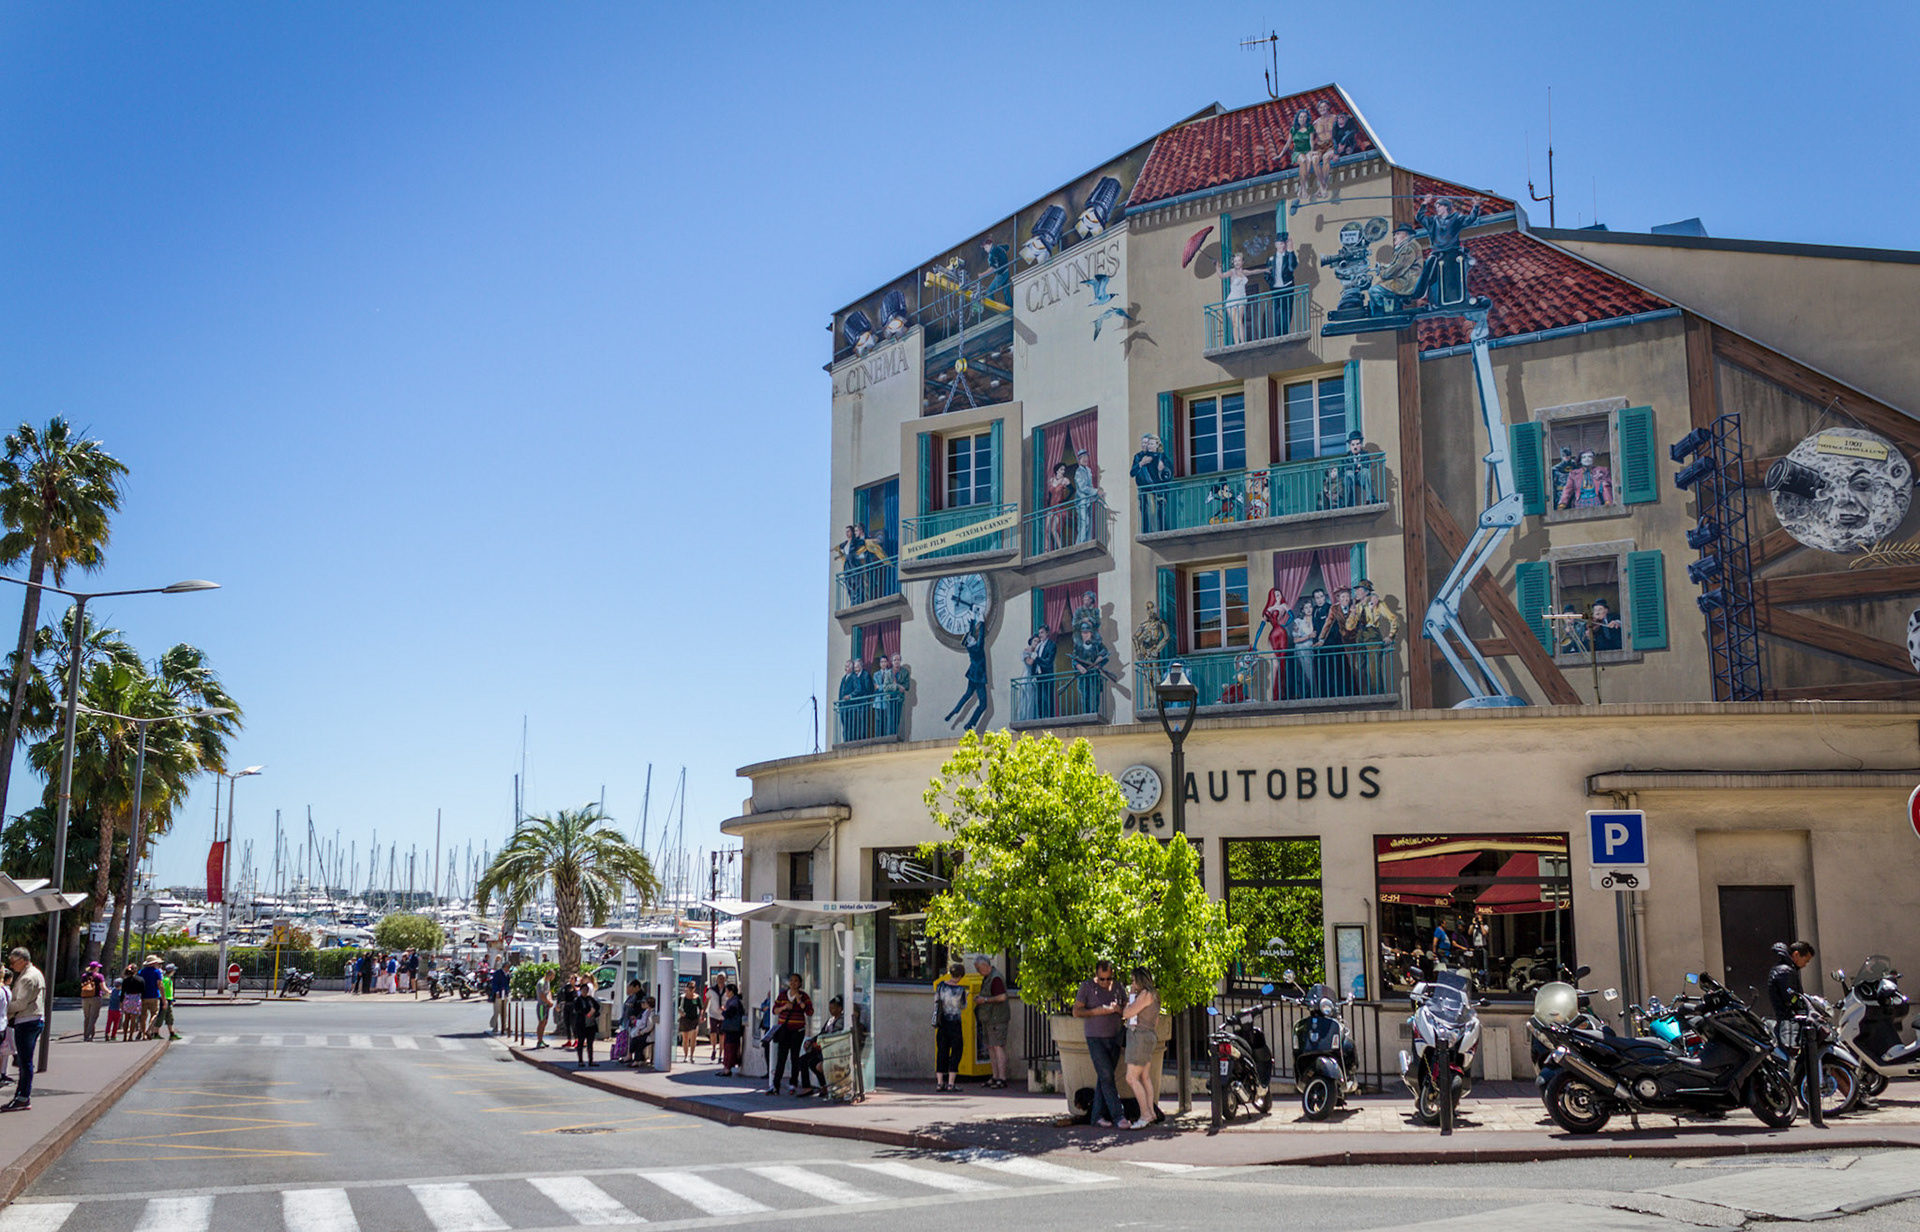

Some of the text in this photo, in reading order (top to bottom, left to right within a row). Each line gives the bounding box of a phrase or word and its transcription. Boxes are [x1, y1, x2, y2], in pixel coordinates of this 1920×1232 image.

[1025, 240, 1120, 312] CANNES
[846, 345, 909, 394] CINEMA
[930, 537, 946, 547] FILM
[1184, 765, 1381, 803] AUTOBUS
[1123, 811, 1165, 833] DES
[1604, 822, 1630, 856] P
[864, 902, 877, 910] Ville
